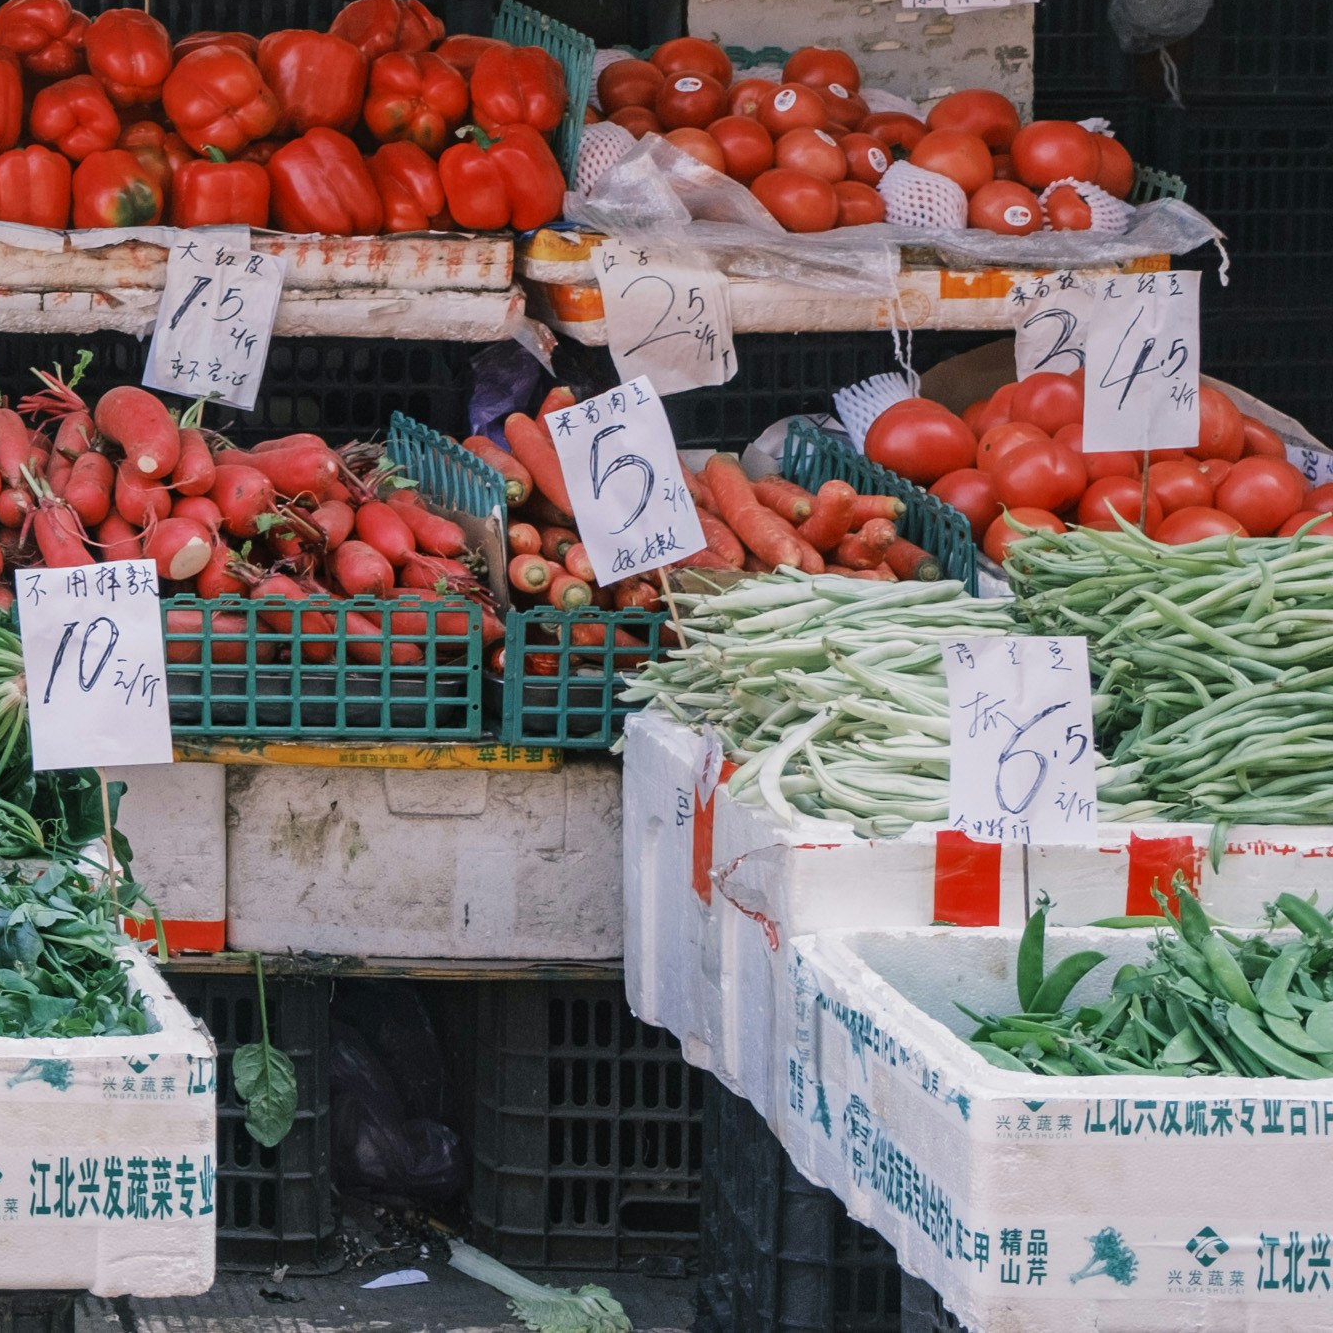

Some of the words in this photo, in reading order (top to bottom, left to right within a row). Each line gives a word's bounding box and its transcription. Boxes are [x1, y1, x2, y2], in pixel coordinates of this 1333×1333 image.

[170, 274, 245, 328] 1.5
[621, 275, 704, 358] 2.5
[1099, 306, 1188, 411] 4.5
[589, 423, 655, 535] 5
[43, 616, 120, 704] 10
[995, 701, 1089, 815] 6.5
[102, 1075, 176, 1093] 兴发蔬菜
[996, 1114, 1073, 1132] 兴发蔬菜
[29, 1154, 215, 1221] 江北兴发蔬菜专业
[999, 1227, 1049, 1257] 精品
[999, 1257, 1049, 1286] 山芹
[1167, 1268, 1246, 1288] 兴发蔬菜
